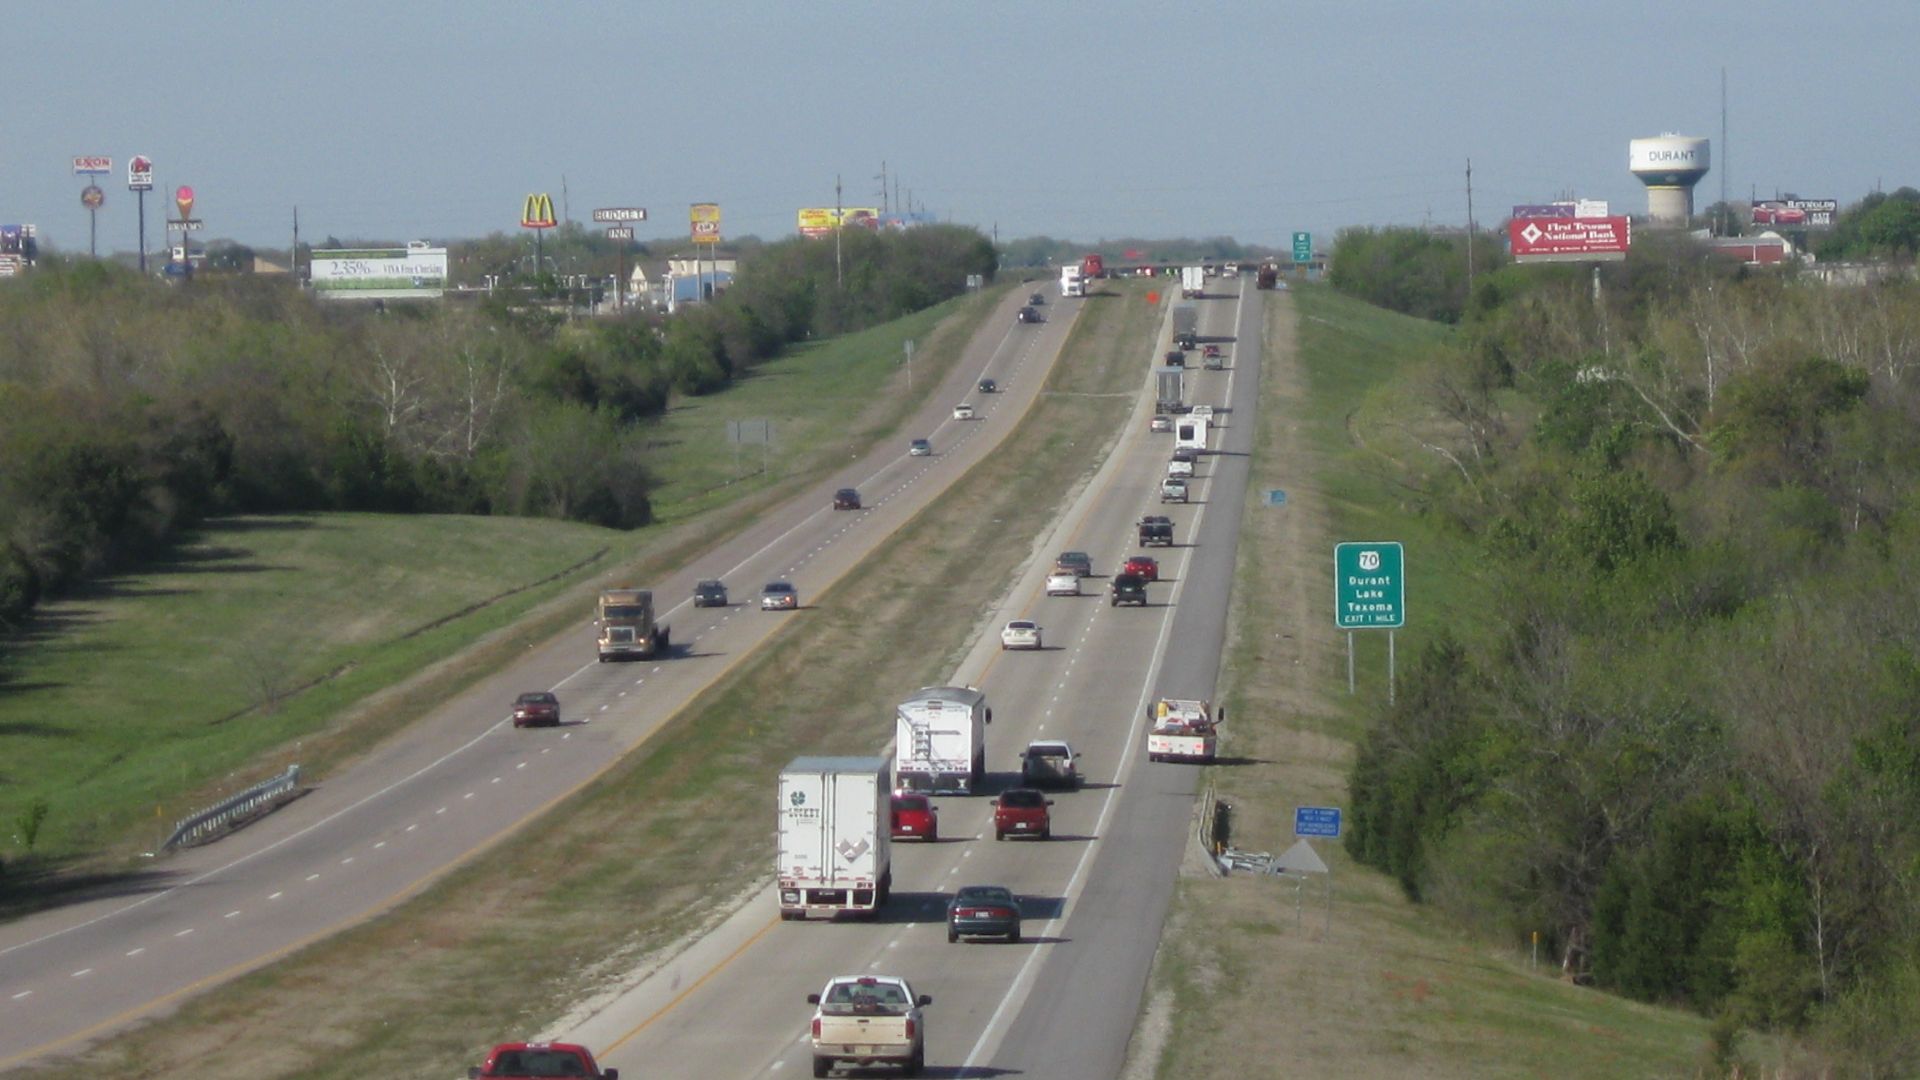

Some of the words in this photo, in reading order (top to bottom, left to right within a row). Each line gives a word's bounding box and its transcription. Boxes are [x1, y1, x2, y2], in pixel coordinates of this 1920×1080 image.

[1649, 151, 1695, 161] DURANT
[75, 157, 110, 168] EXXON
[595, 209, 644, 220] BUDGET
[1547, 223, 1571, 231] First
[608, 228, 632, 239] INN
[1544, 231, 1587, 240] National
[1589, 230, 1616, 239] Bank
[1360, 554, 1378, 566] 70
[1349, 576, 1391, 585] Durant
[1356, 590, 1383, 598] Lake
[1348, 602, 1393, 612] Texoma
[1345, 614, 1364, 622] EXIT
[1375, 614, 1395, 622] MILE
